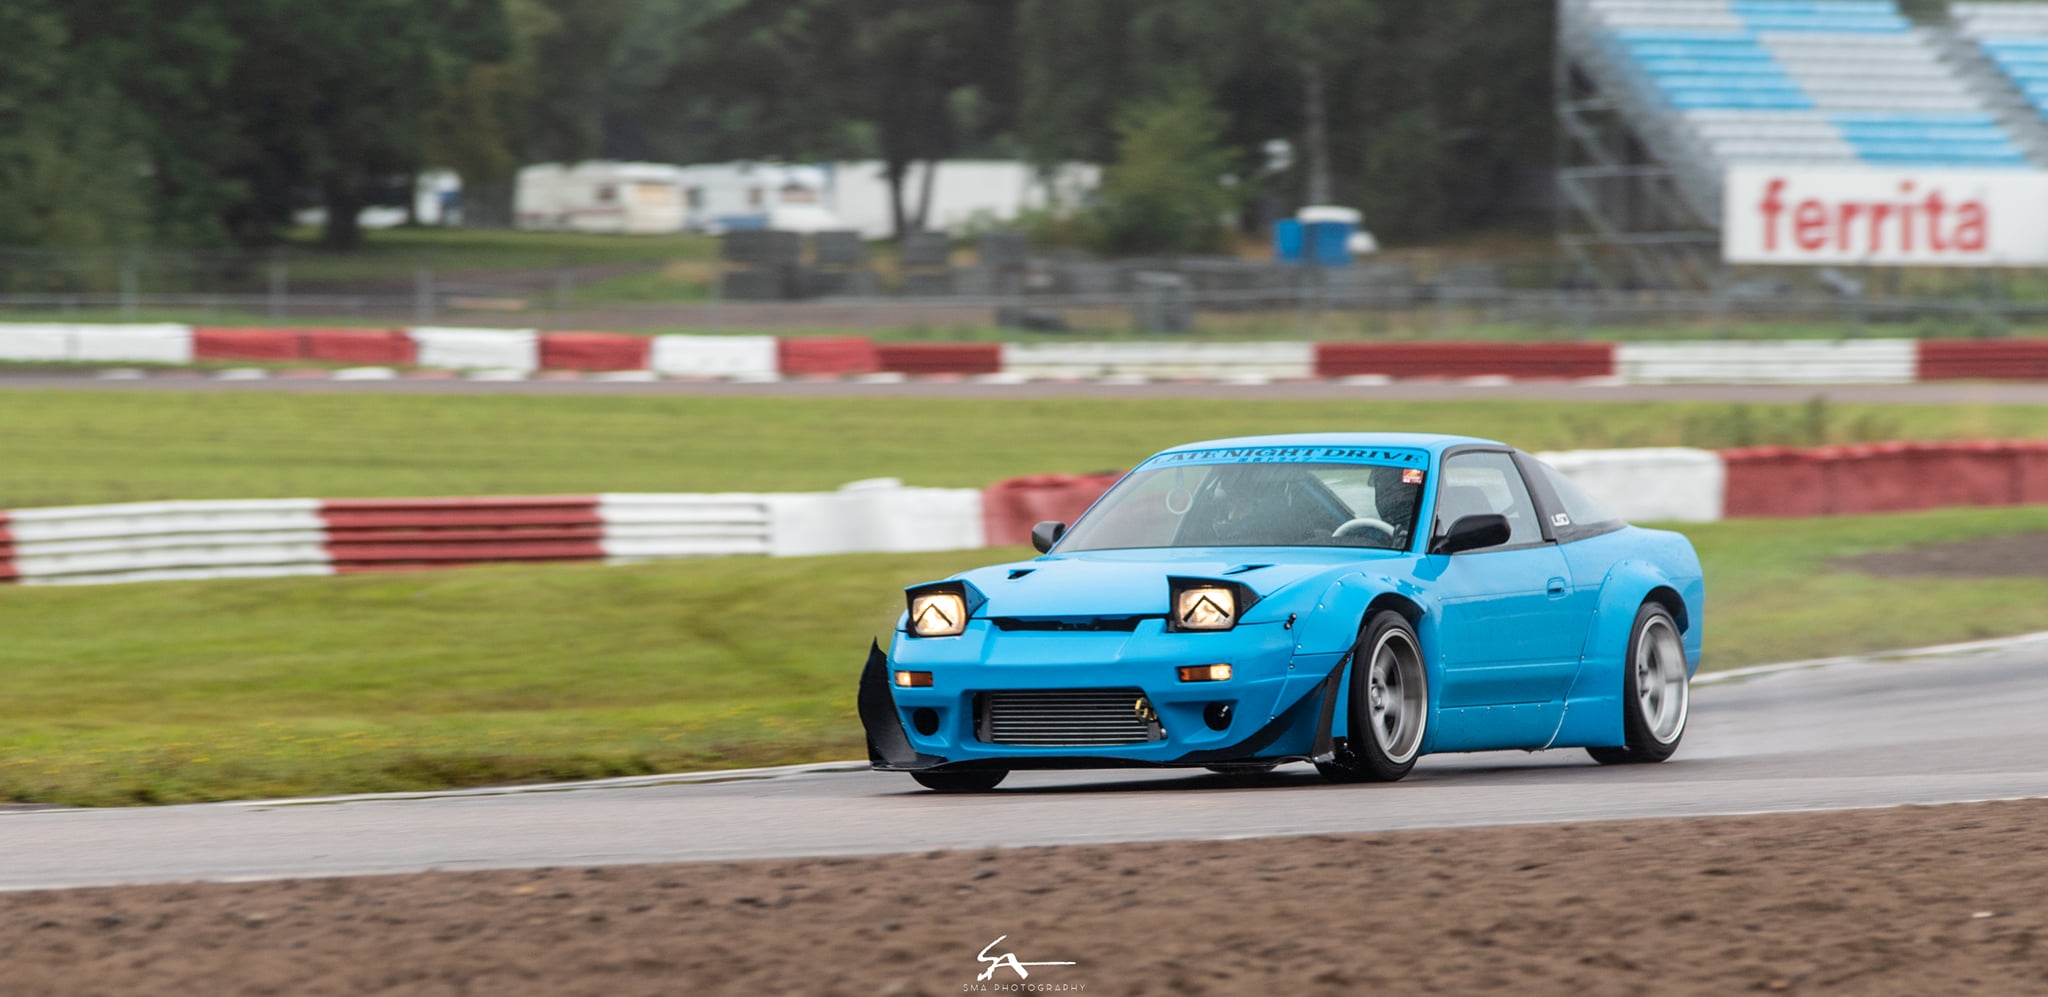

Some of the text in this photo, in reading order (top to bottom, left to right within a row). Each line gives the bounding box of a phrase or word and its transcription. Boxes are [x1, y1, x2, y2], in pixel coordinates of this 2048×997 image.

[1759, 178, 1990, 252] ferrita
[1222, 448, 1321, 457] NIGHT
[1323, 449, 1424, 463] DRIVE
